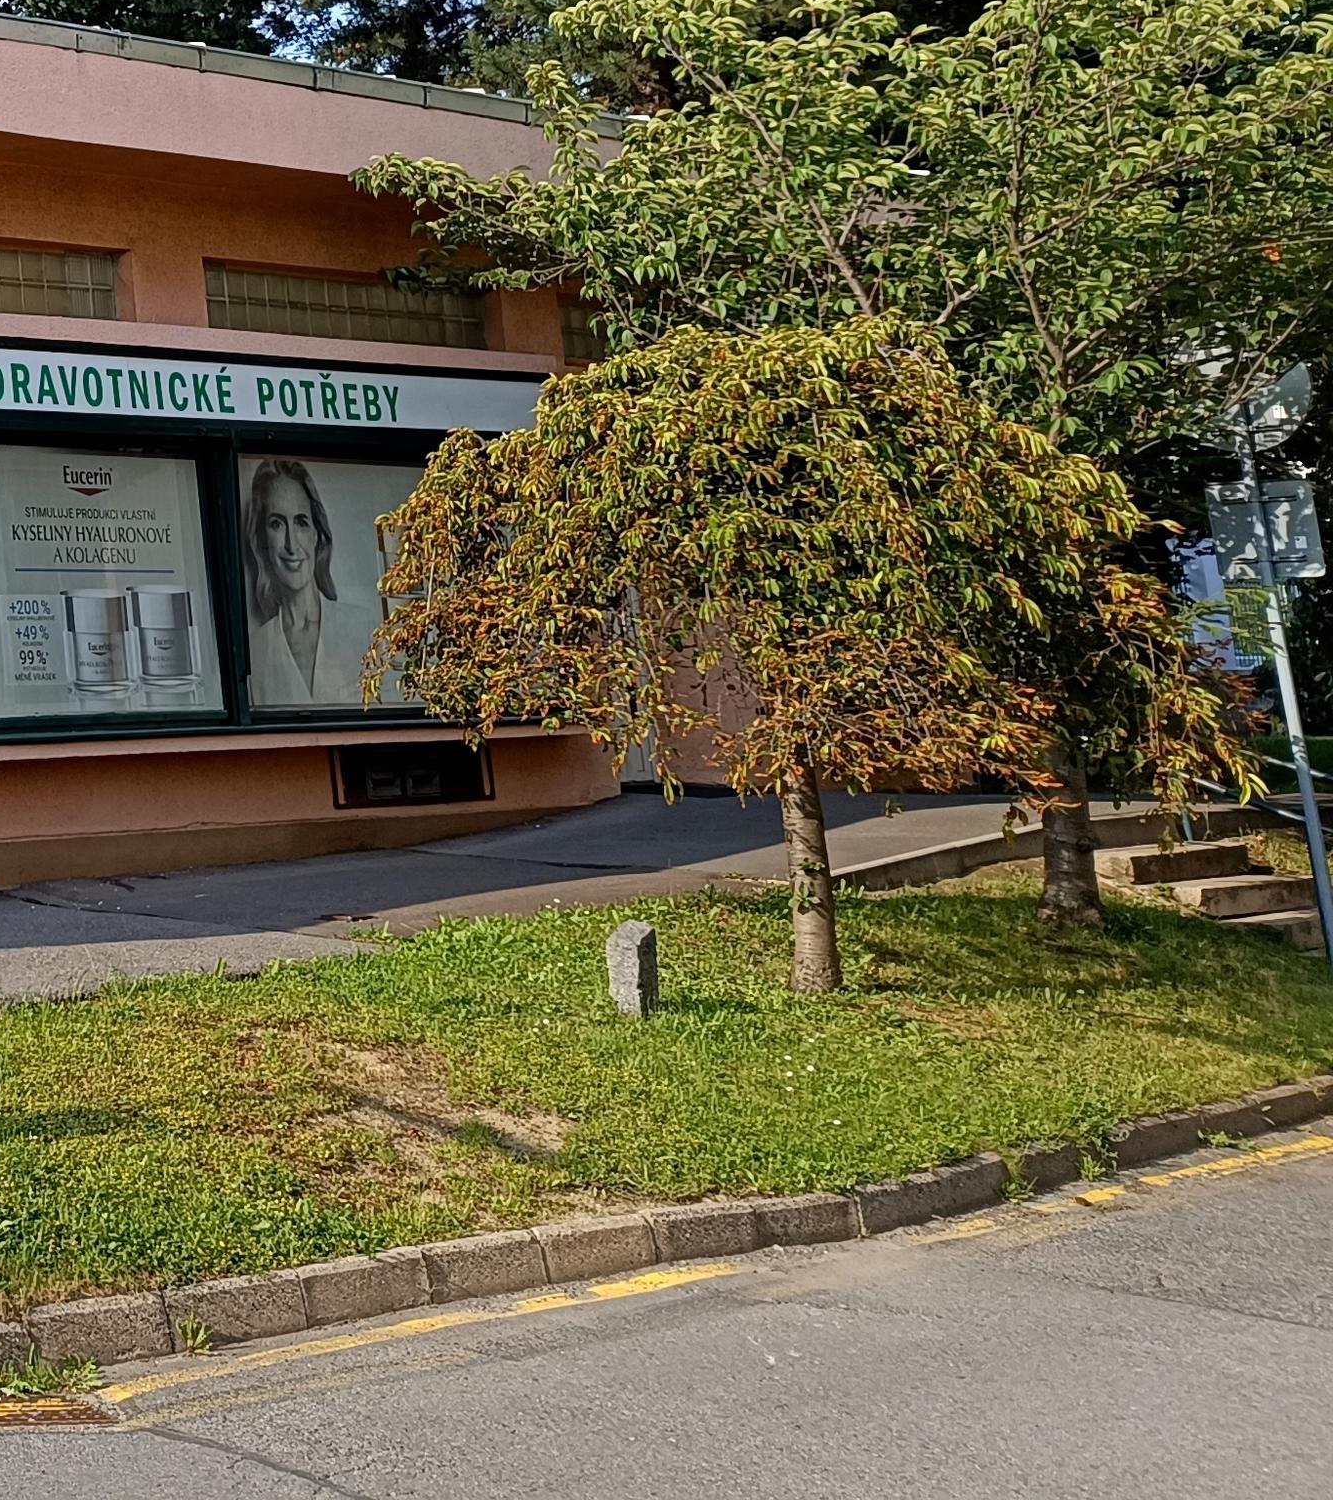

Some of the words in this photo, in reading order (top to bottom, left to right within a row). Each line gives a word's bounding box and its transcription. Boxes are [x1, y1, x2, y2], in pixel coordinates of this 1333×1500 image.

[256, 372, 400, 422] POTŘEBY
[63, 465, 112, 485] Eucerin
[25, 506, 73, 519] STIMULUJE
[76, 508, 118, 520] PRODUKCI
[120, 509, 156, 521] VLASTNÍ
[12, 524, 72, 542] KYSELINY
[76, 524, 172, 544] HYALURONOVÉ
[53, 547, 63, 563] A
[66, 547, 136, 564] KOLAGENU
